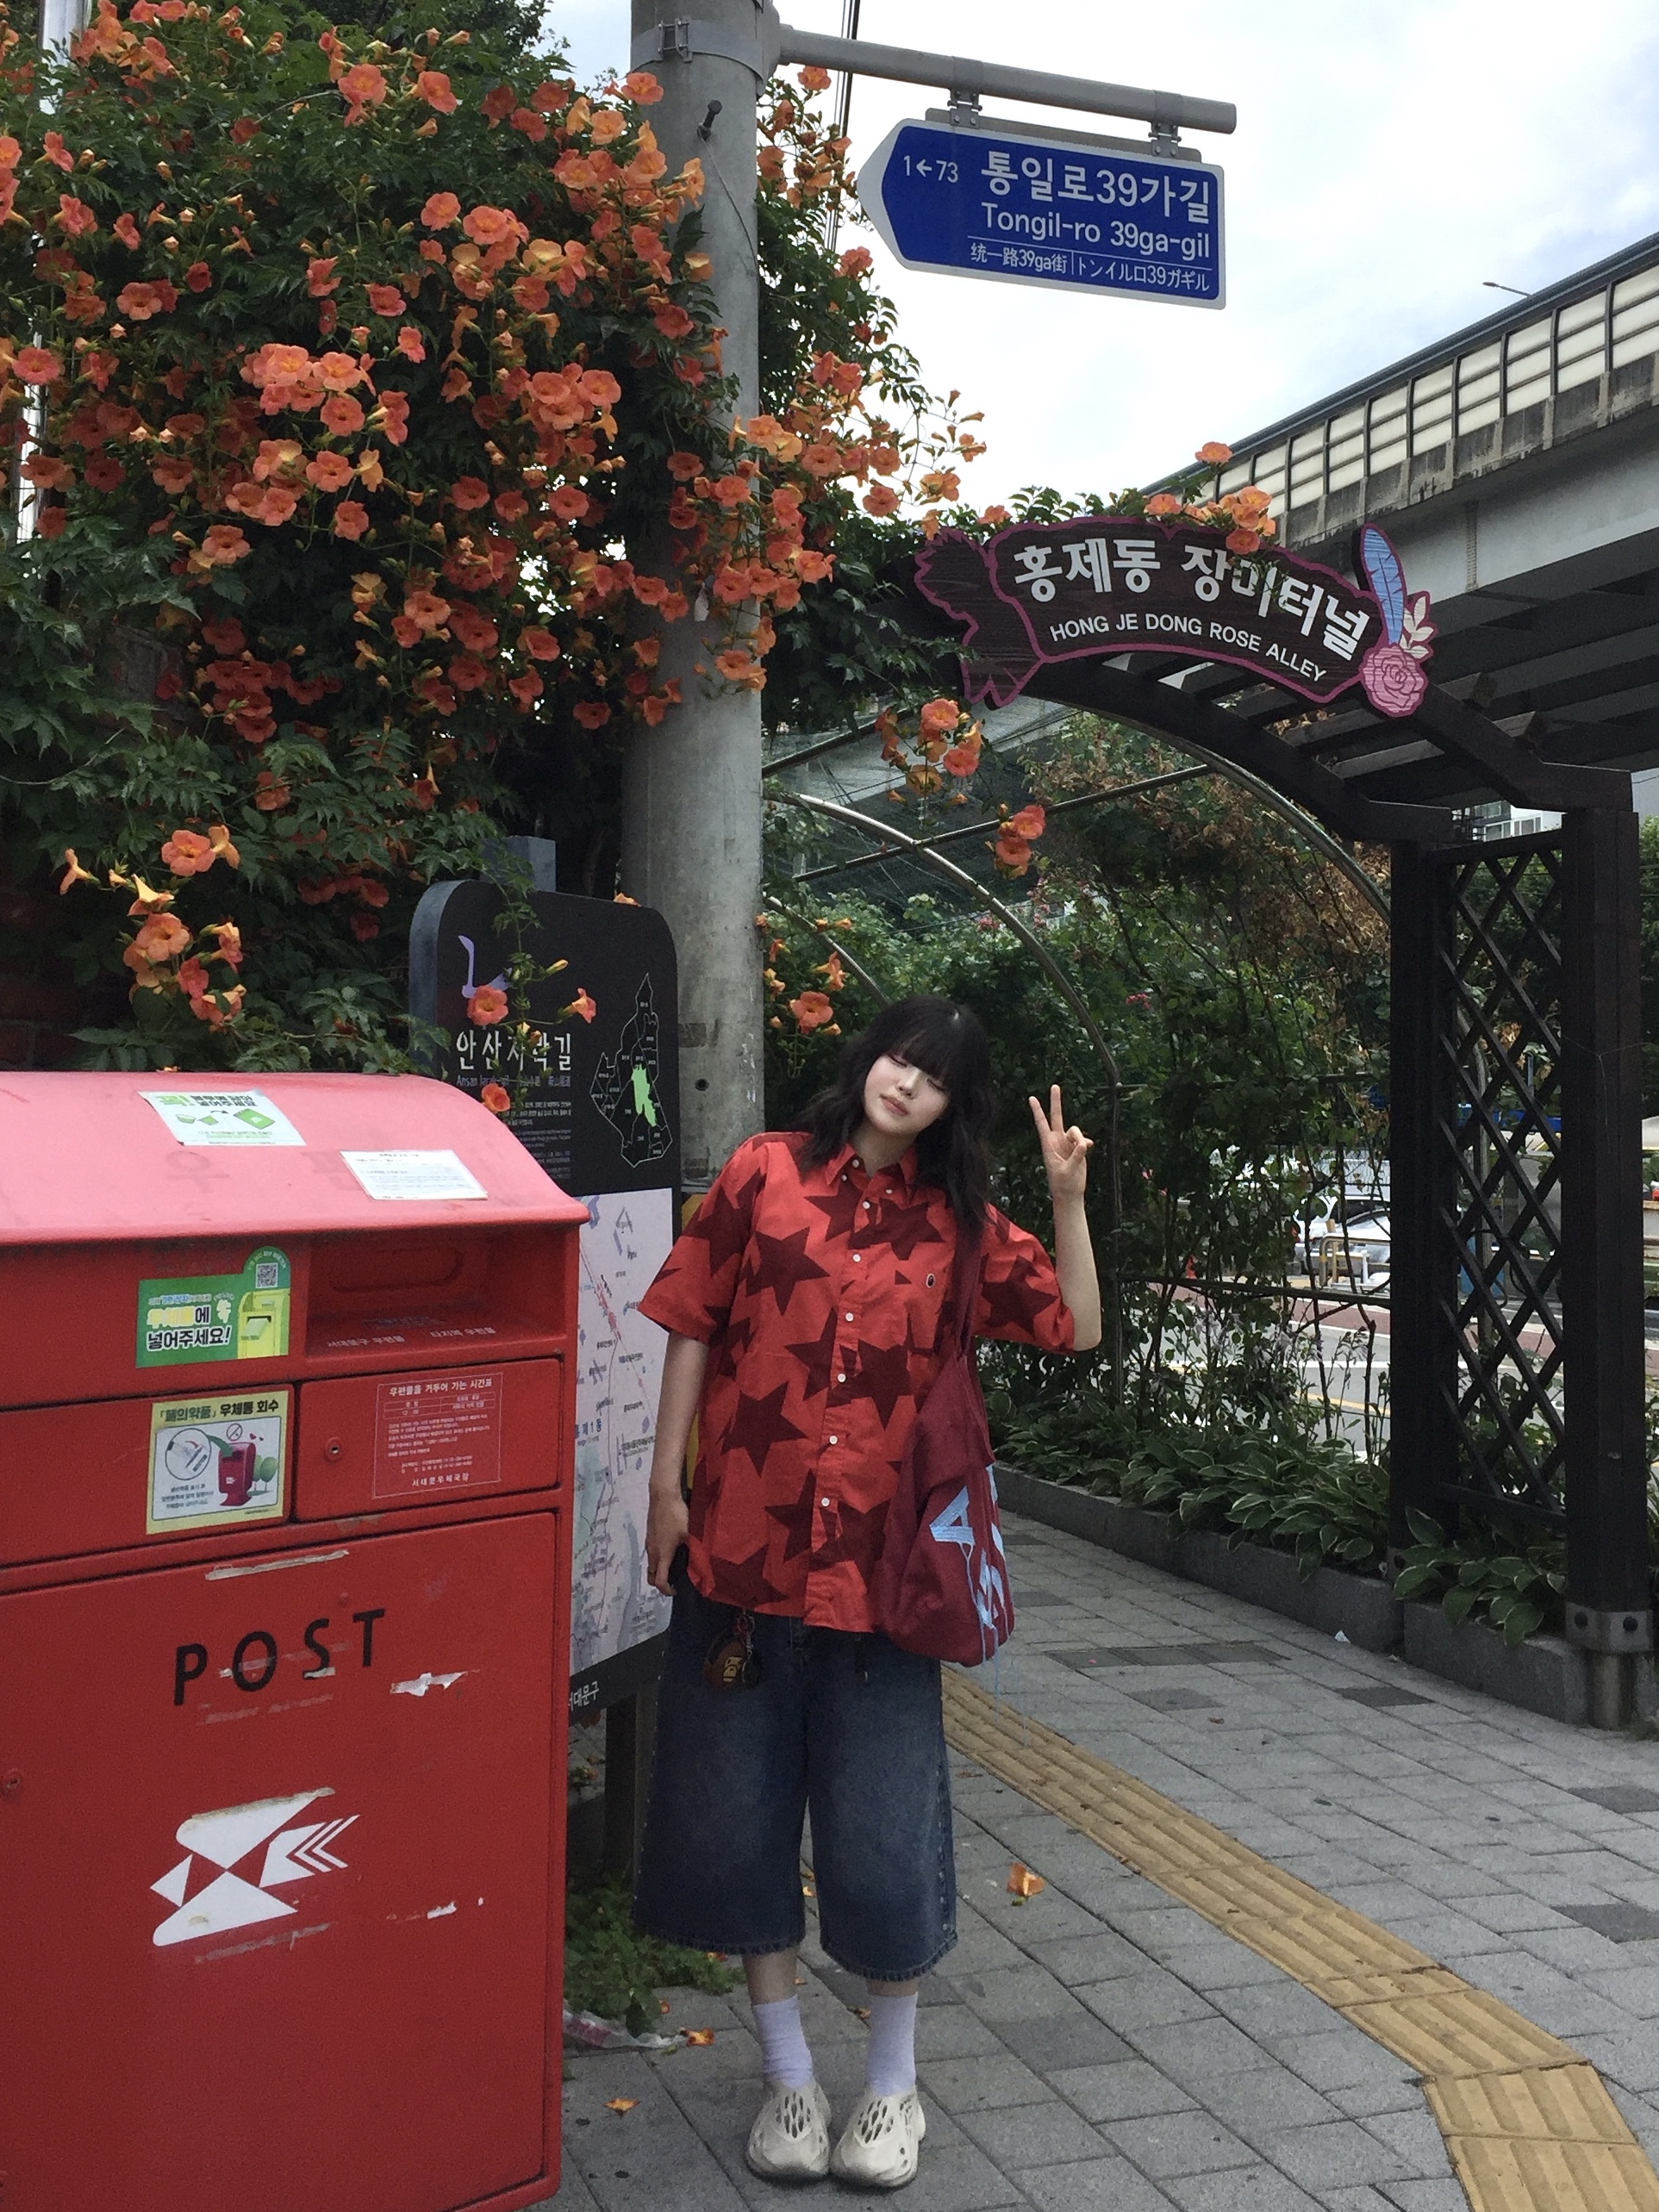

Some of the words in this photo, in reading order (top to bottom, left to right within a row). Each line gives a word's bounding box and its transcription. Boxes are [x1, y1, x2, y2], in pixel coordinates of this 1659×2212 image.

[935, 159, 959, 184] 73
[981, 150, 1210, 225] 통일로39가길
[981, 201, 1101, 243] Tongil-ro
[1109, 220, 1210, 262] 39ga-gil
[970, 241, 1068, 275] 统一路39ga街
[1078, 256, 1211, 292] トンイルロ39ガギル
[1013, 537, 1162, 602] 홍제동
[1180, 544, 1370, 662] 장미터널
[1049, 614, 1110, 642] HONG
[1115, 613, 1139, 631] JE
[1144, 613, 1203, 636] DONG
[1208, 621, 1263, 653] ROSE
[1265, 643, 1327, 682] ALLEY
[147, 1325, 233, 1351] 넣어주세요!
[389, 1384, 421, 1397] 우편물을
[452, 1380, 467, 1391] 가는
[470, 1378, 493, 1389] 시간표
[220, 1401, 253, 1418] 우체통
[256, 1399, 279, 1413] 회수
[173, 1608, 385, 1706] POST
